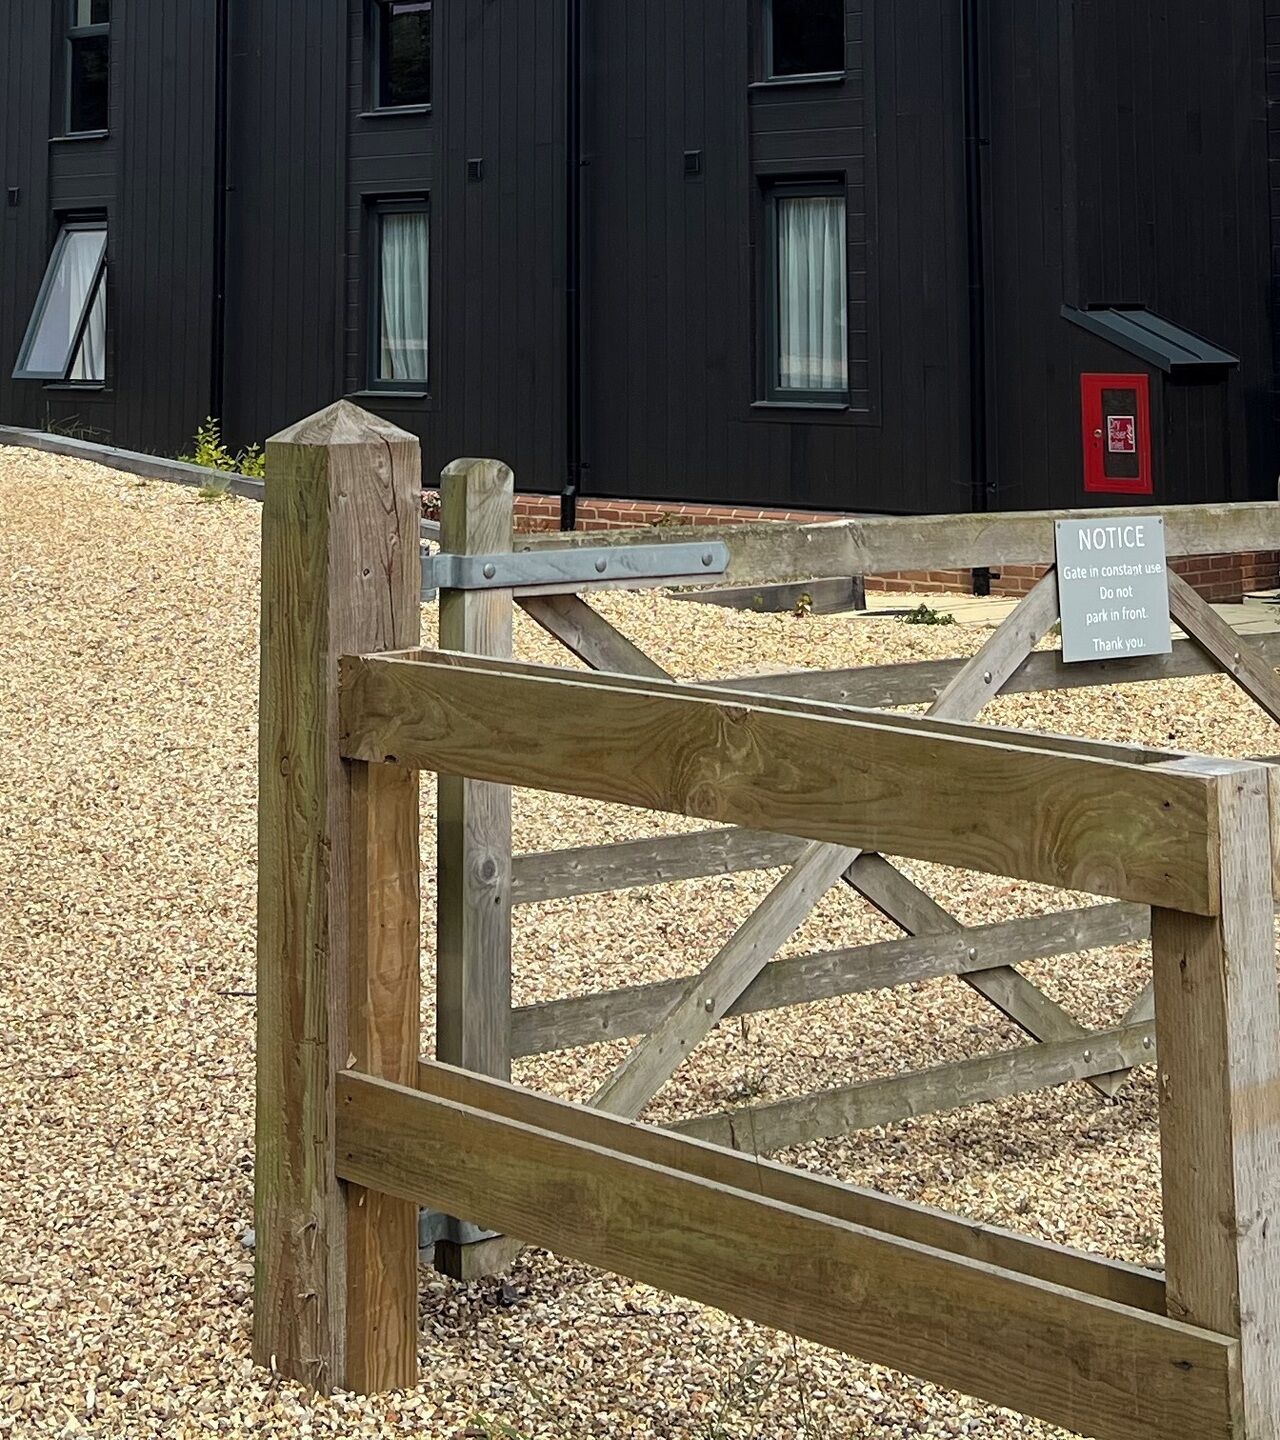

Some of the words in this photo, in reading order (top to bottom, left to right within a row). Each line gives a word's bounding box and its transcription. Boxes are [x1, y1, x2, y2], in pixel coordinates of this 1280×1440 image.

[1078, 525, 1145, 551] NOTICE
[1063, 566, 1087, 580] Gate
[1089, 565, 1098, 578] in
[1101, 563, 1142, 577] constant
[1145, 563, 1164, 574] use.
[1100, 586, 1114, 600] Do
[1116, 585, 1134, 598] not
[1086, 608, 1108, 626] park
[1110, 608, 1120, 621] in
[1092, 636, 1123, 652] Thank
[1125, 637, 1146, 652] you.
